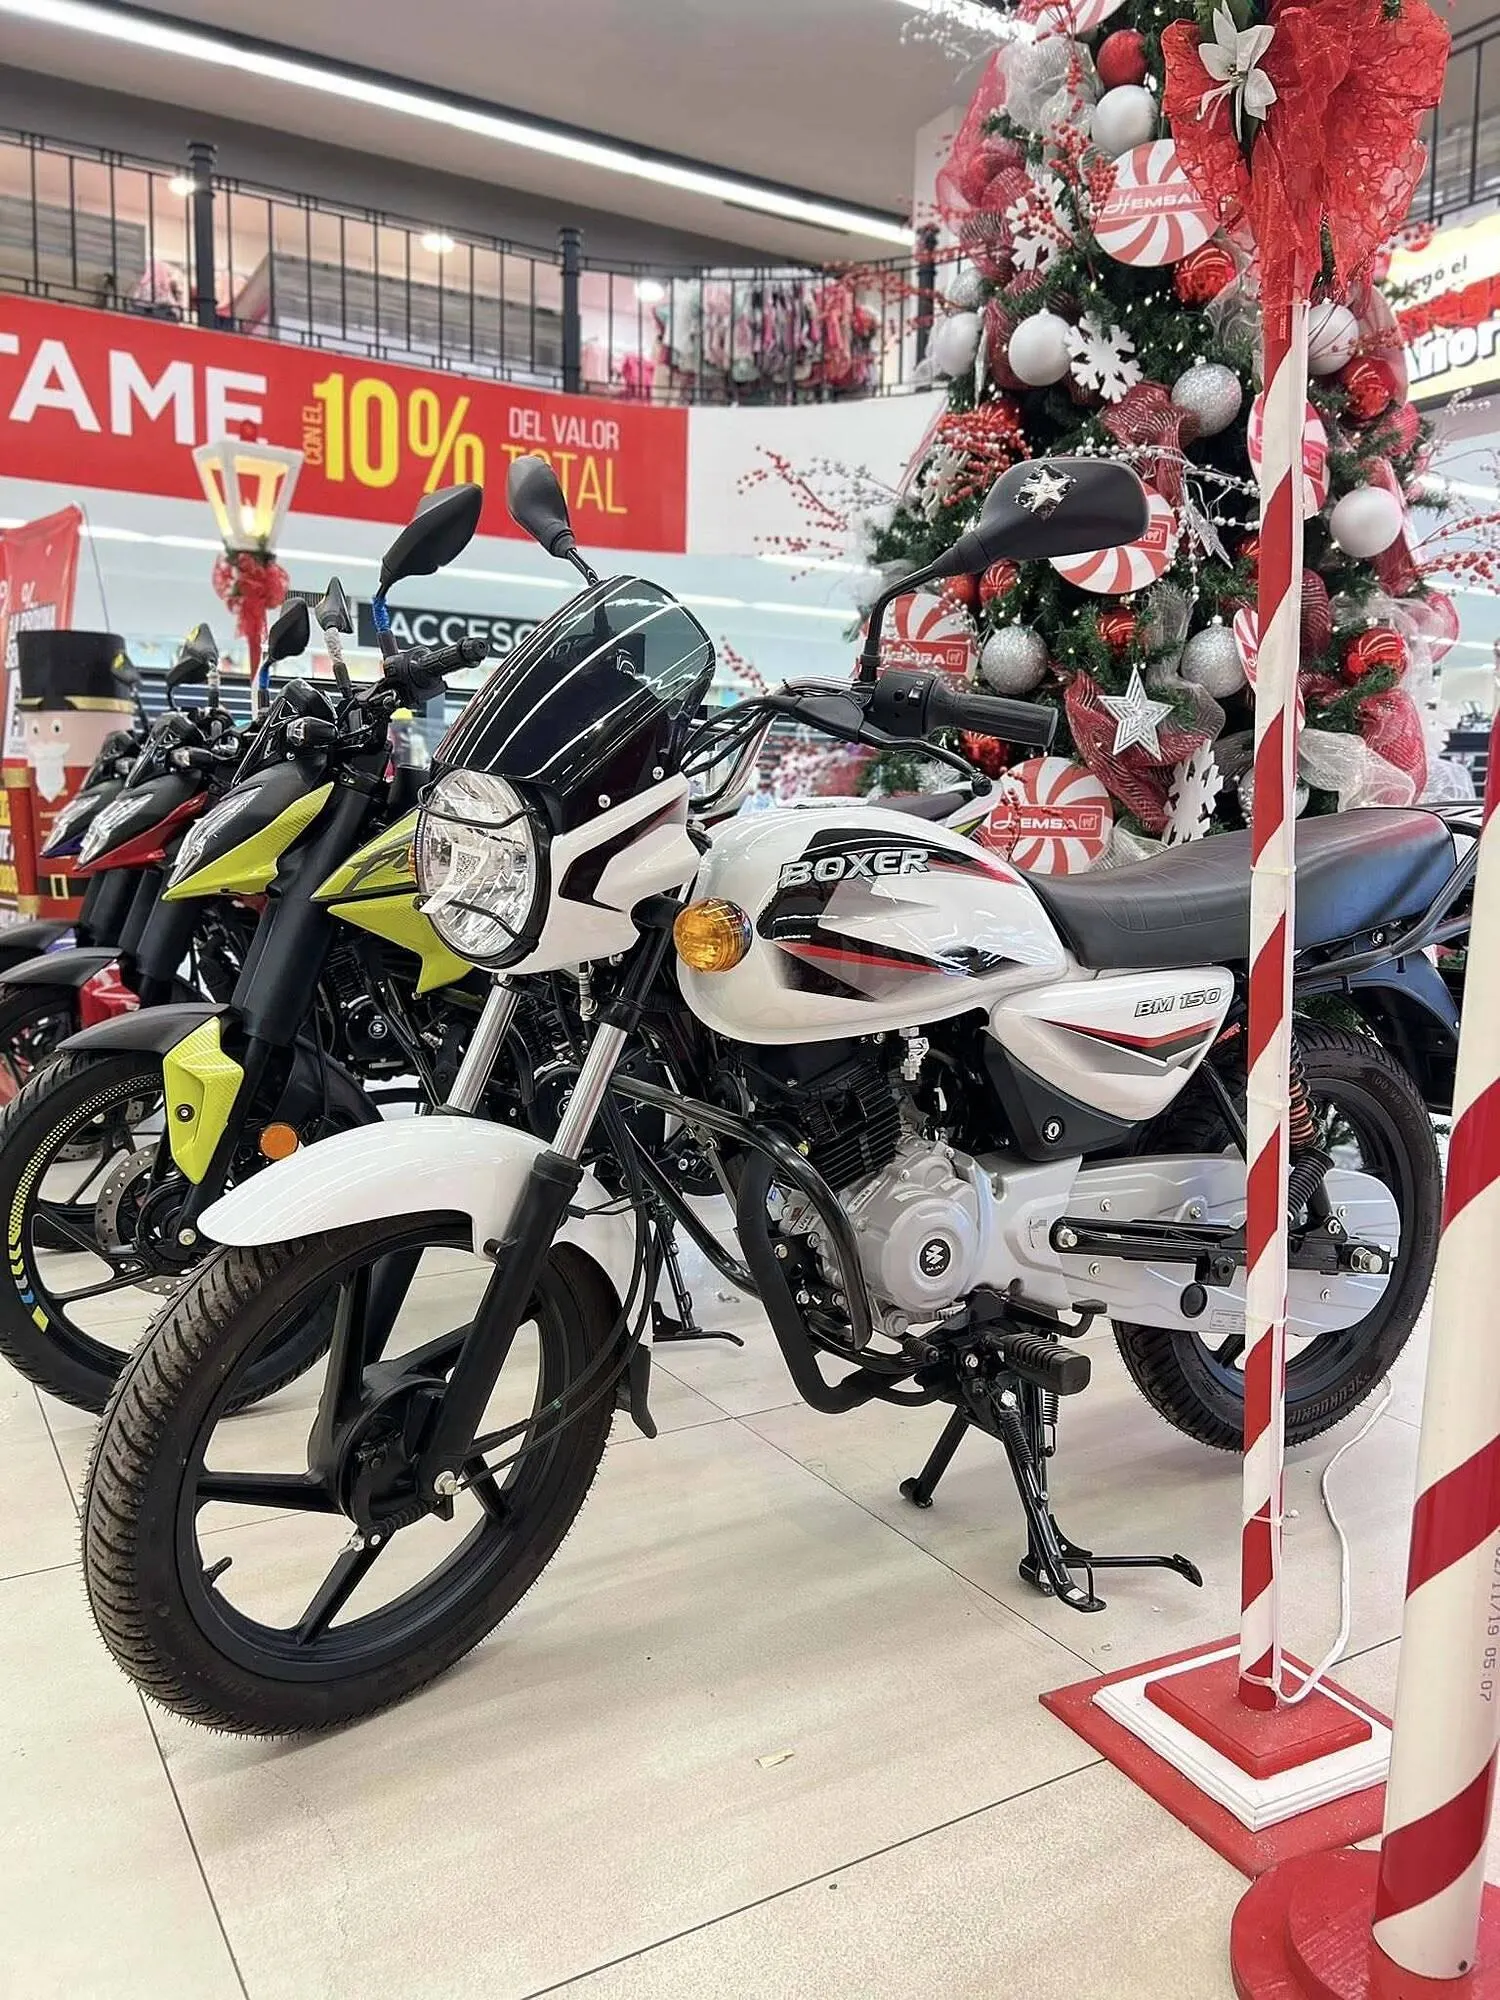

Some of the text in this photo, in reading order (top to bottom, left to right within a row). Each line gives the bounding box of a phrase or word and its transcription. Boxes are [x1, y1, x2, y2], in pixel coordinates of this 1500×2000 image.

[302, 402, 323, 465] CON EL
[312, 372, 485, 494] 10%
[509, 407, 620, 451] DEL VALOR
[777, 850, 931, 891] BOXER
[1134, 987, 1222, 1018] BM 150
[1480, 1647, 1497, 1702] 05:07
